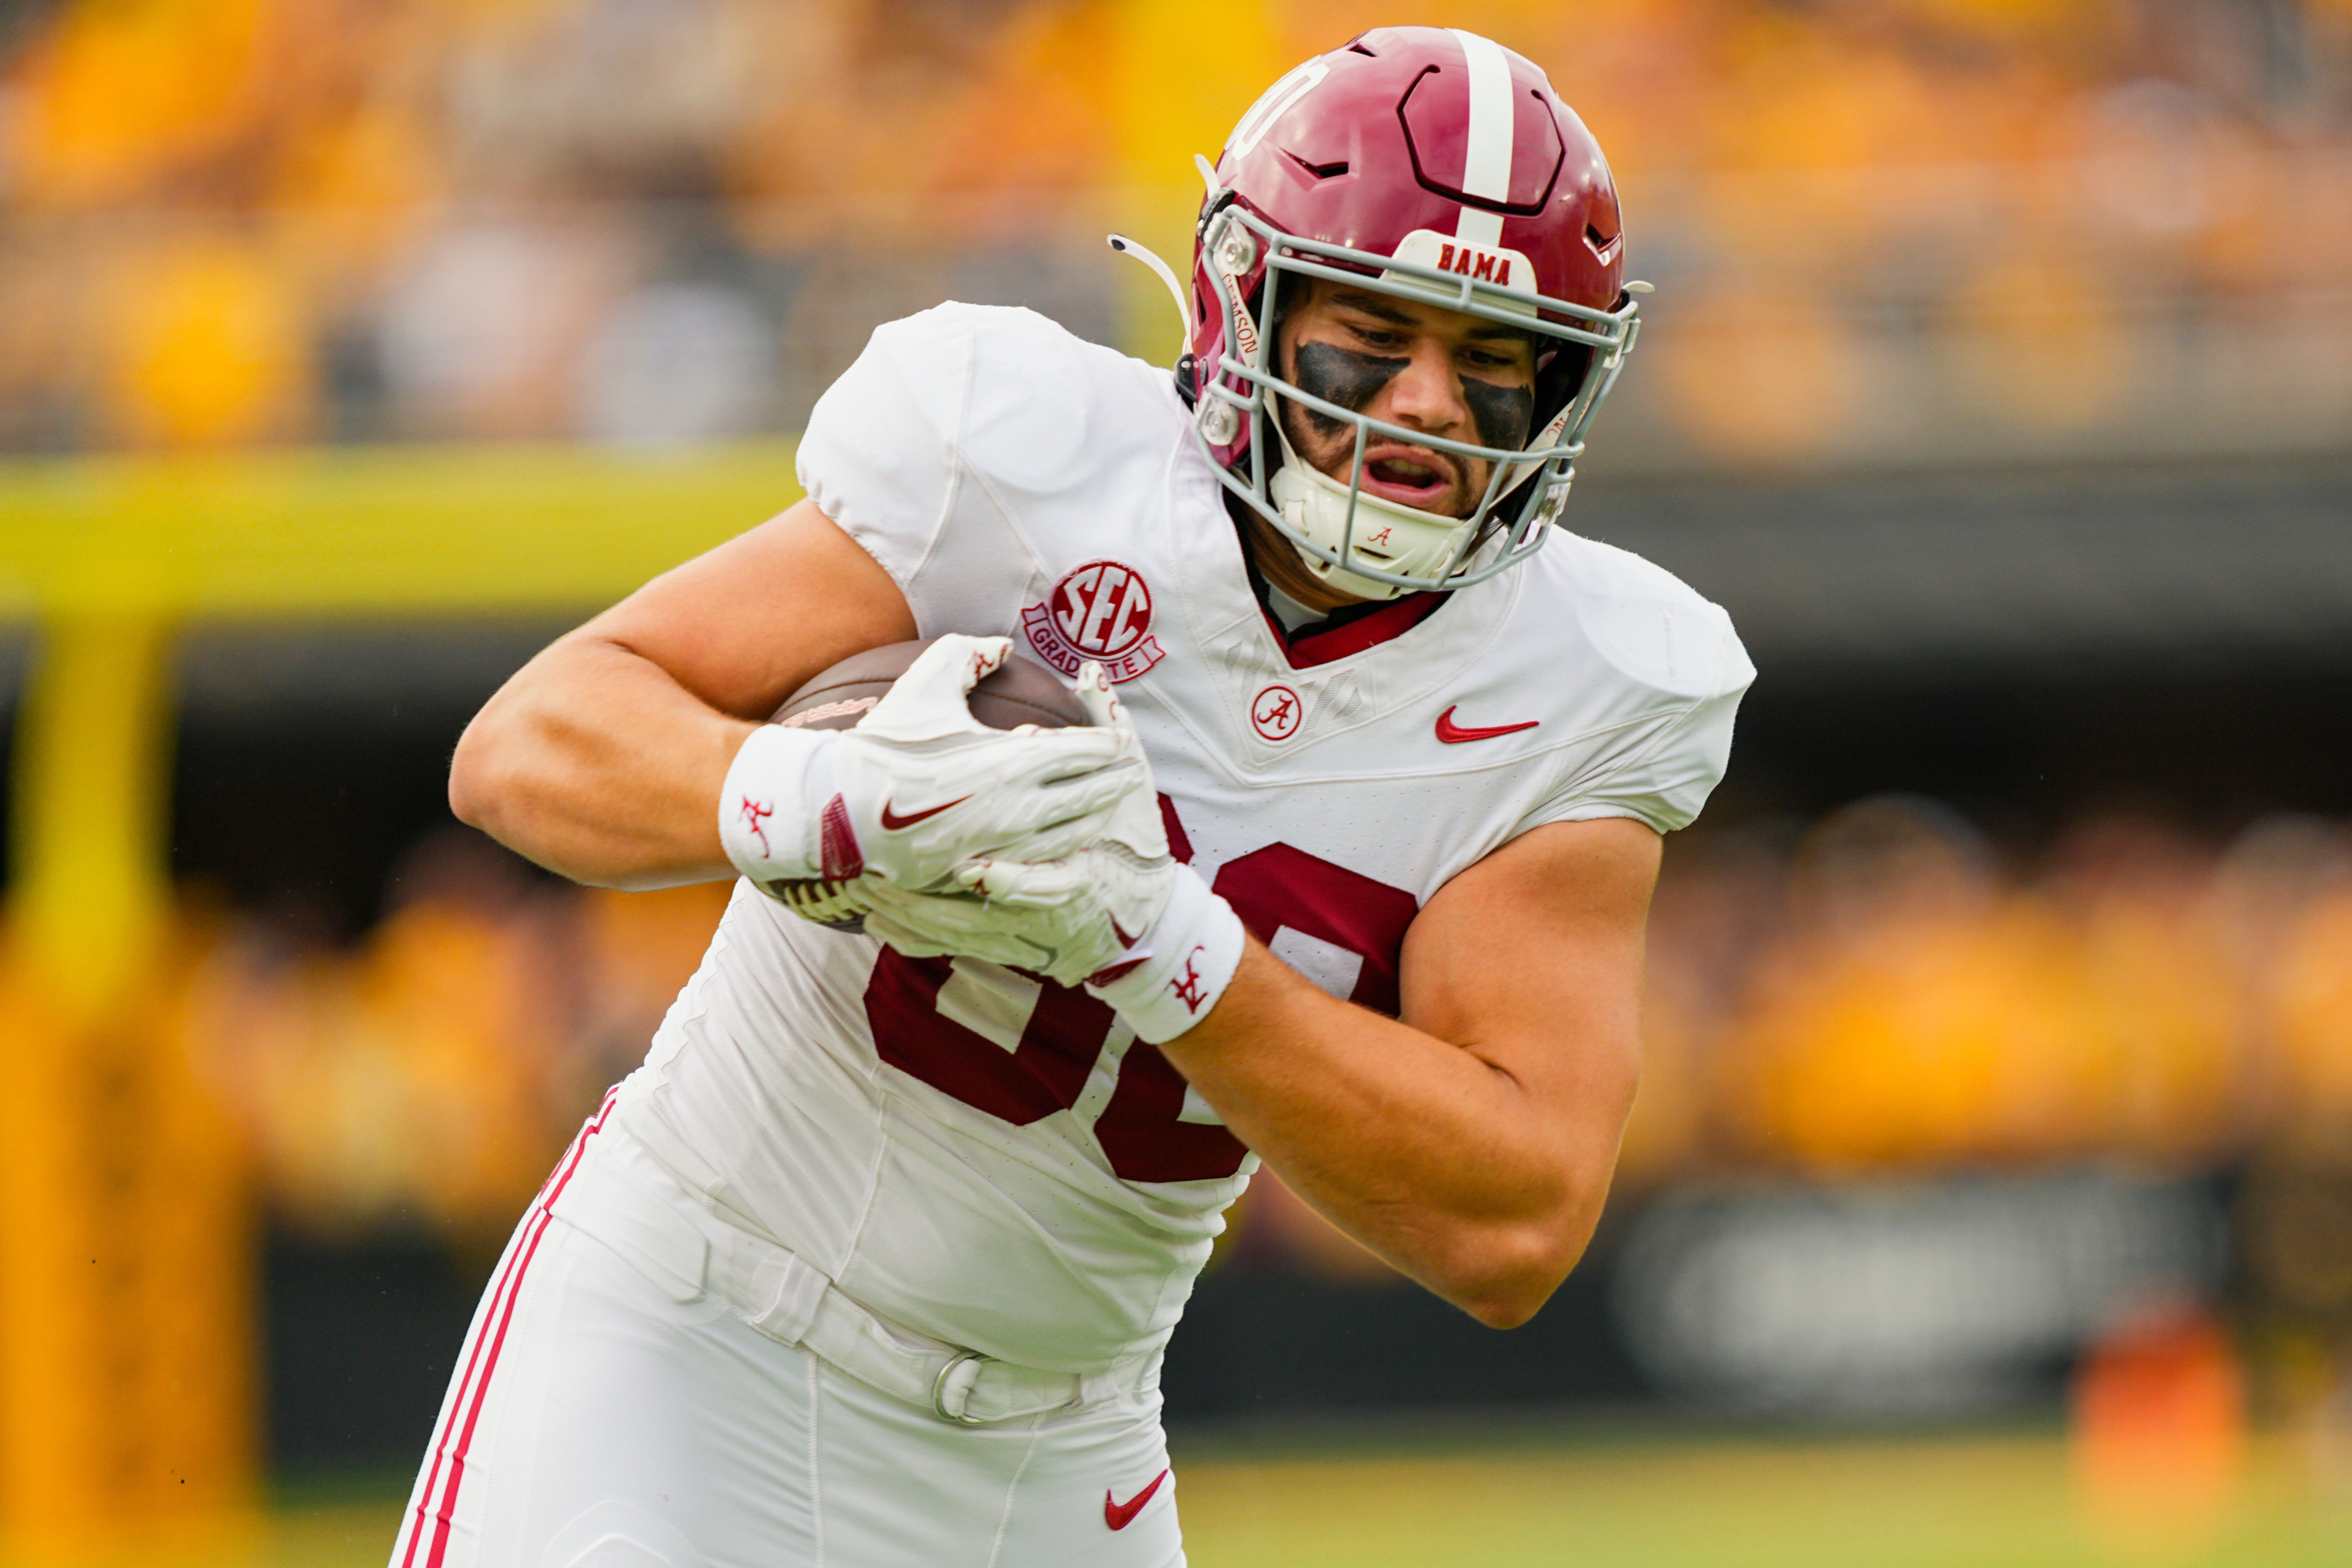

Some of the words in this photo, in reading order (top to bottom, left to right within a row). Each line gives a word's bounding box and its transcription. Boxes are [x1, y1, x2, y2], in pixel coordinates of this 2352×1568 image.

[1437, 243, 1511, 286] BAMA
[1222, 274, 1258, 353] CMSON
[1367, 525, 1392, 546] A
[1056, 565, 1148, 653] SEC
[1033, 628, 1138, 680] GRADTE
[1256, 692, 1294, 731] A
